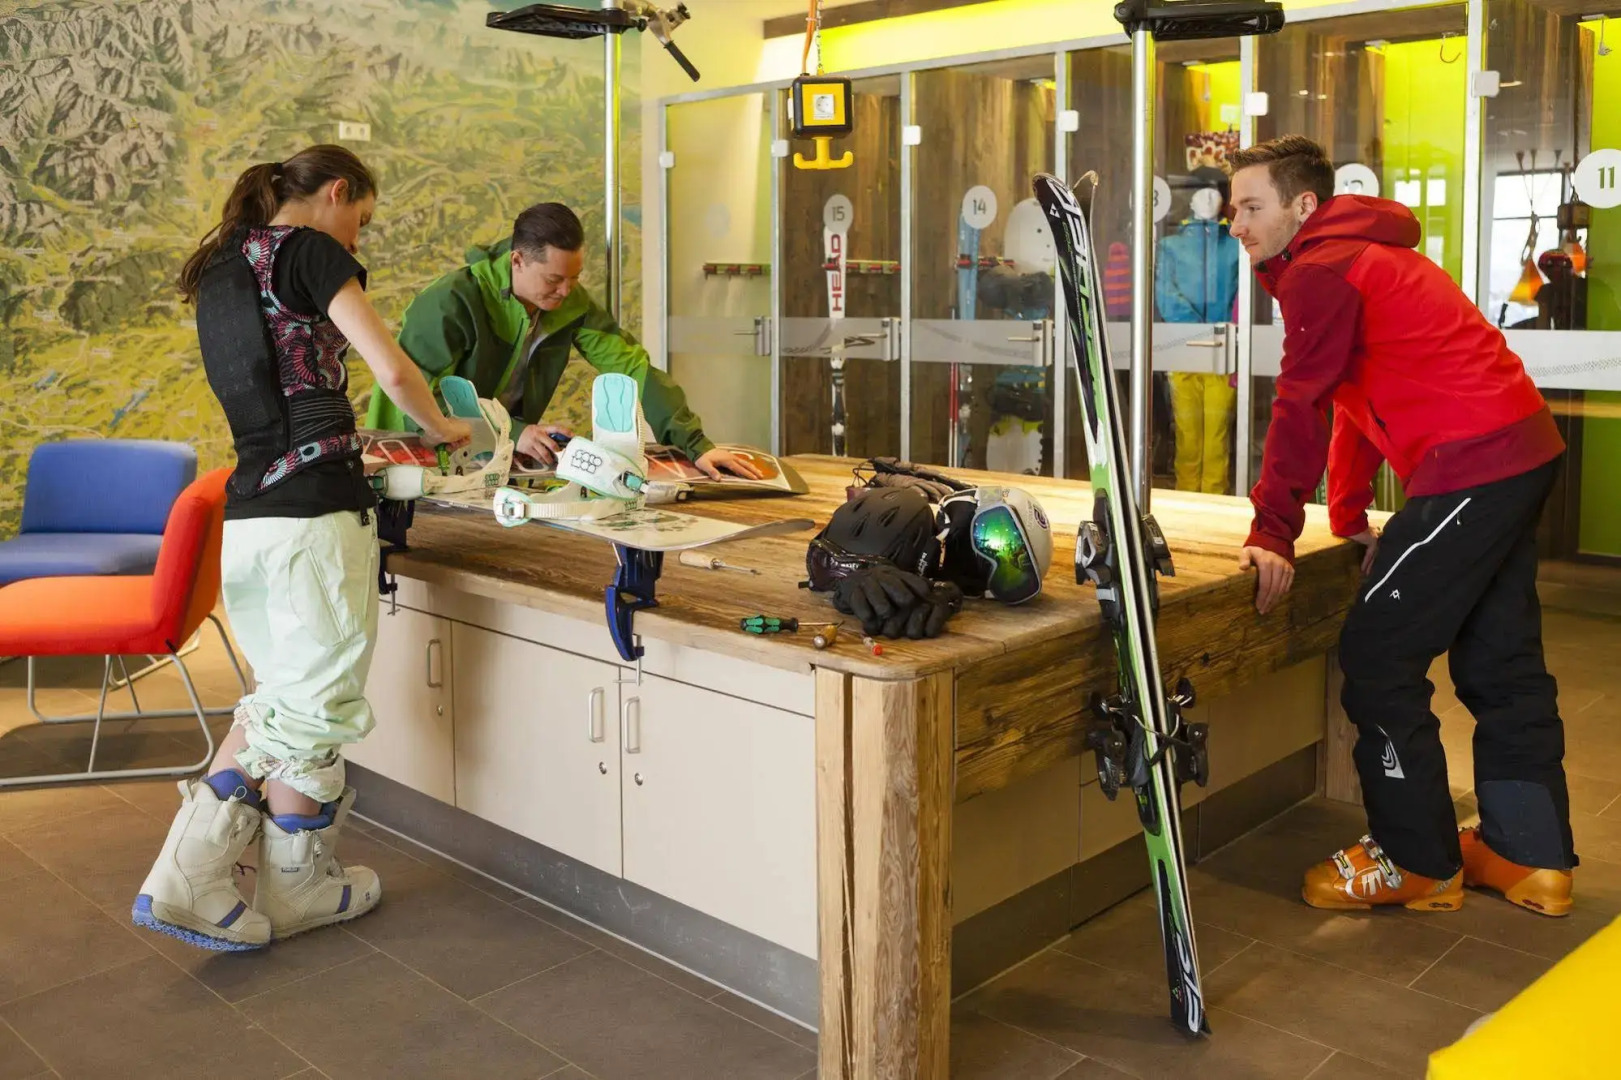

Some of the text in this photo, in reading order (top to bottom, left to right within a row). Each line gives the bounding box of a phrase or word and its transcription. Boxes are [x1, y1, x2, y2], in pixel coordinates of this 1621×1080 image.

[1597, 166, 1615, 189] 11
[831, 206, 845, 221] 15
[972, 198, 987, 215] 14
